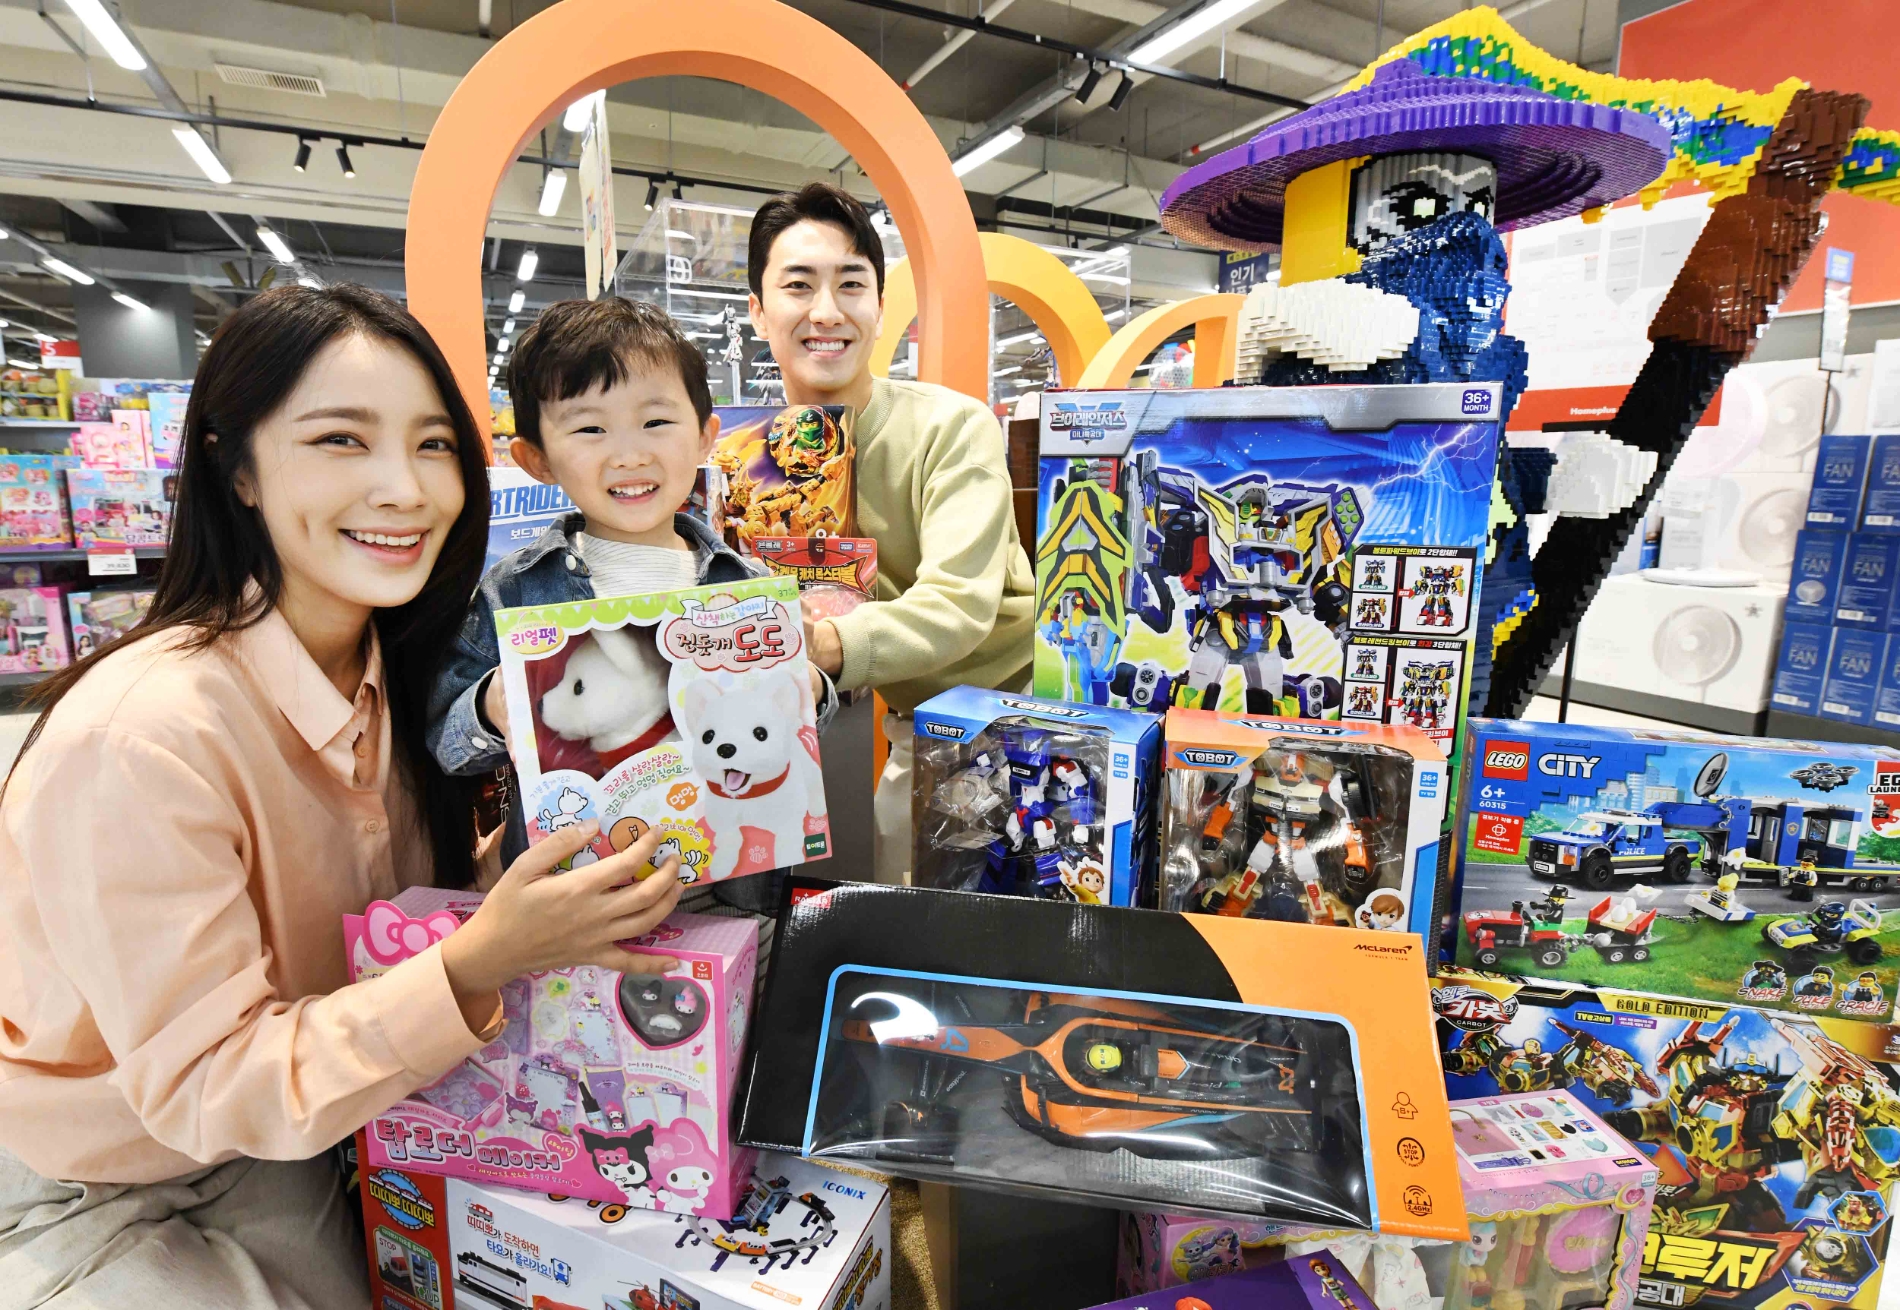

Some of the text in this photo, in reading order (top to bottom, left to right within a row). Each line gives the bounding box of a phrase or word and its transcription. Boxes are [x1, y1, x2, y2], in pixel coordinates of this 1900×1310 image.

[1230, 263, 1255, 286] 인기
[44, 343, 57, 356] 5
[1464, 392, 1490, 404] 36+
[1463, 404, 1489, 412] MONTH
[1570, 406, 1617, 417] Homeplus
[1049, 411, 1126, 428] 브이레인저스
[1823, 462, 1854, 479] FAN
[1881, 463, 1900, 480] FA
[1801, 557, 1831, 574] FAN
[1853, 562, 1885, 579] FAN
[696, 602, 765, 626] 산책하는 강아지
[511, 627, 558, 646] 리얼펫
[676, 624, 786, 662] 진돗개 도도
[1788, 650, 1818, 666] FAN
[1839, 654, 1872, 671] FAN
[1002, 699, 1089, 718] TOBOT
[926, 723, 965, 739] TOBOT
[1247, 719, 1342, 736] TOBOT
[1115, 755, 1128, 763] 36+
[1186, 751, 1235, 765] TOBOT
[1486, 750, 1602, 780] LEGO CITY
[604, 753, 680, 794] 꼬리를 살랑살랑~
[636, 773, 656, 789] 멍멍
[1880, 774, 1900, 786] EG
[669, 786, 696, 805] 멍멍
[1480, 784, 1506, 798] 6+
[1479, 801, 1507, 810] 60315
[1353, 944, 1408, 954] McLaren
[1440, 986, 1470, 1003] 헬로
[1738, 987, 1786, 997] SNAKE
[1793, 995, 1833, 1005] DUKE
[1445, 1000, 1509, 1024] 카봇
[1616, 999, 1710, 1019] GOLD EDITION
[1836, 1001, 1889, 1011] GRACIE
[1456, 1020, 1488, 1028] CARBOT
[376, 1117, 561, 1171] 탑로더 메이커
[822, 1180, 867, 1201] ICONIX
[369, 1182, 435, 1228] 띠띠뽀 띠띠뽀
[1407, 1204, 1430, 1212] 2.4GHz
[379, 1238, 397, 1251] STOP
[467, 1215, 540, 1258] 띠띠뽀가 도착하면
[486, 1238, 553, 1278] 타요가 올라가요!
[1636, 1277, 1686, 1307] 공대
